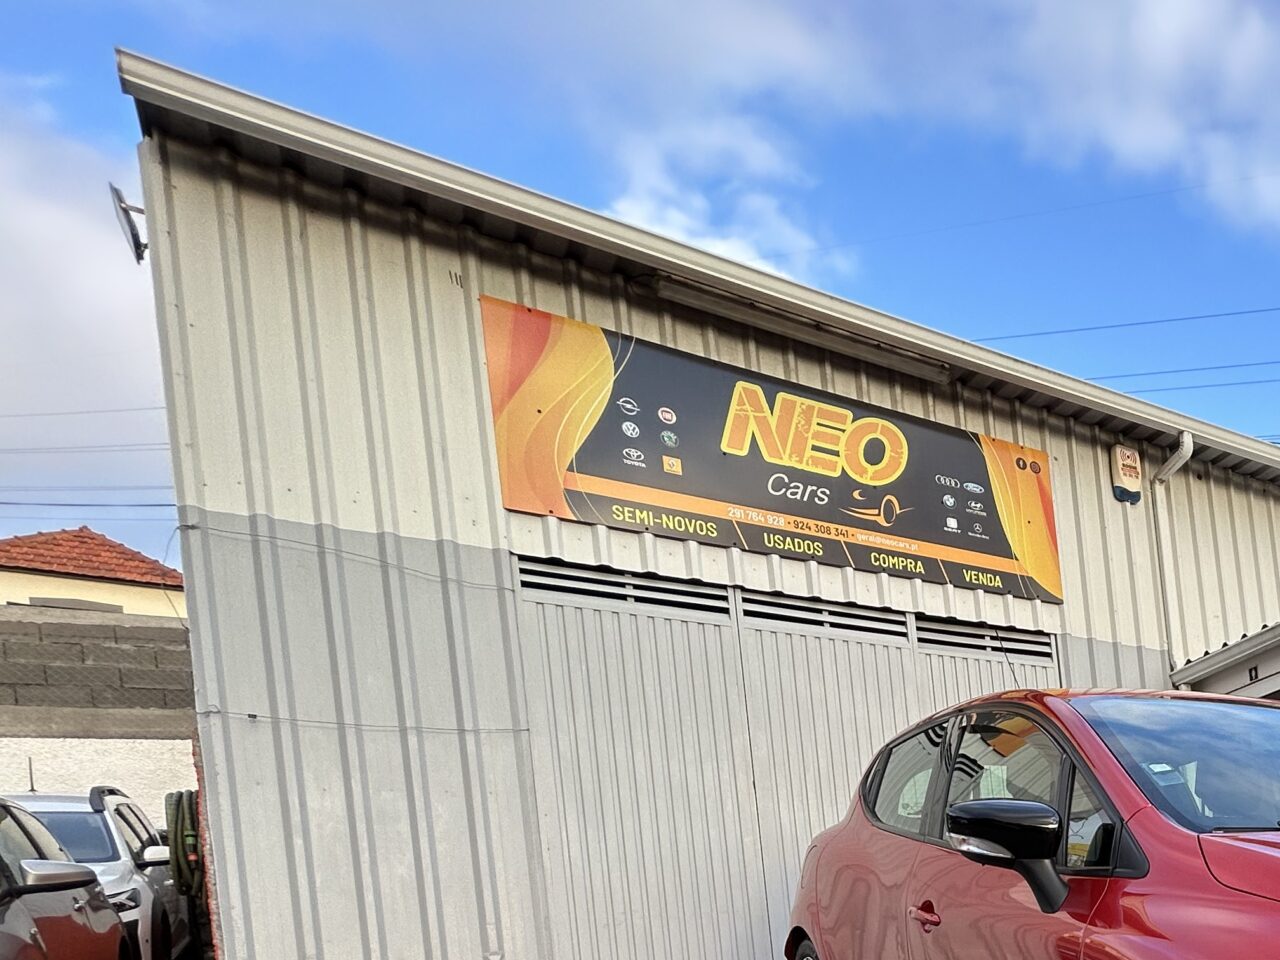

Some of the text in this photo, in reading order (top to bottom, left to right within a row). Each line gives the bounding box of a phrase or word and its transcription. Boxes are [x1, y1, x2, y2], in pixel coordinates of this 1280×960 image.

[720, 380, 908, 486] NEO
[623, 459, 646, 468] TOYOTA
[767, 473, 831, 505] Cars
[612, 504, 718, 538] SEMI-NOVOS
[728, 507, 744, 519] 291
[747, 511, 765, 522] 764
[767, 514, 785, 526] 928
[793, 520, 811, 532] 924
[814, 524, 831, 536] 308
[834, 527, 849, 539] 341
[763, 532, 823, 556] USADOS
[870, 552, 925, 575] COMPRA
[962, 568, 1003, 589] VENDA
